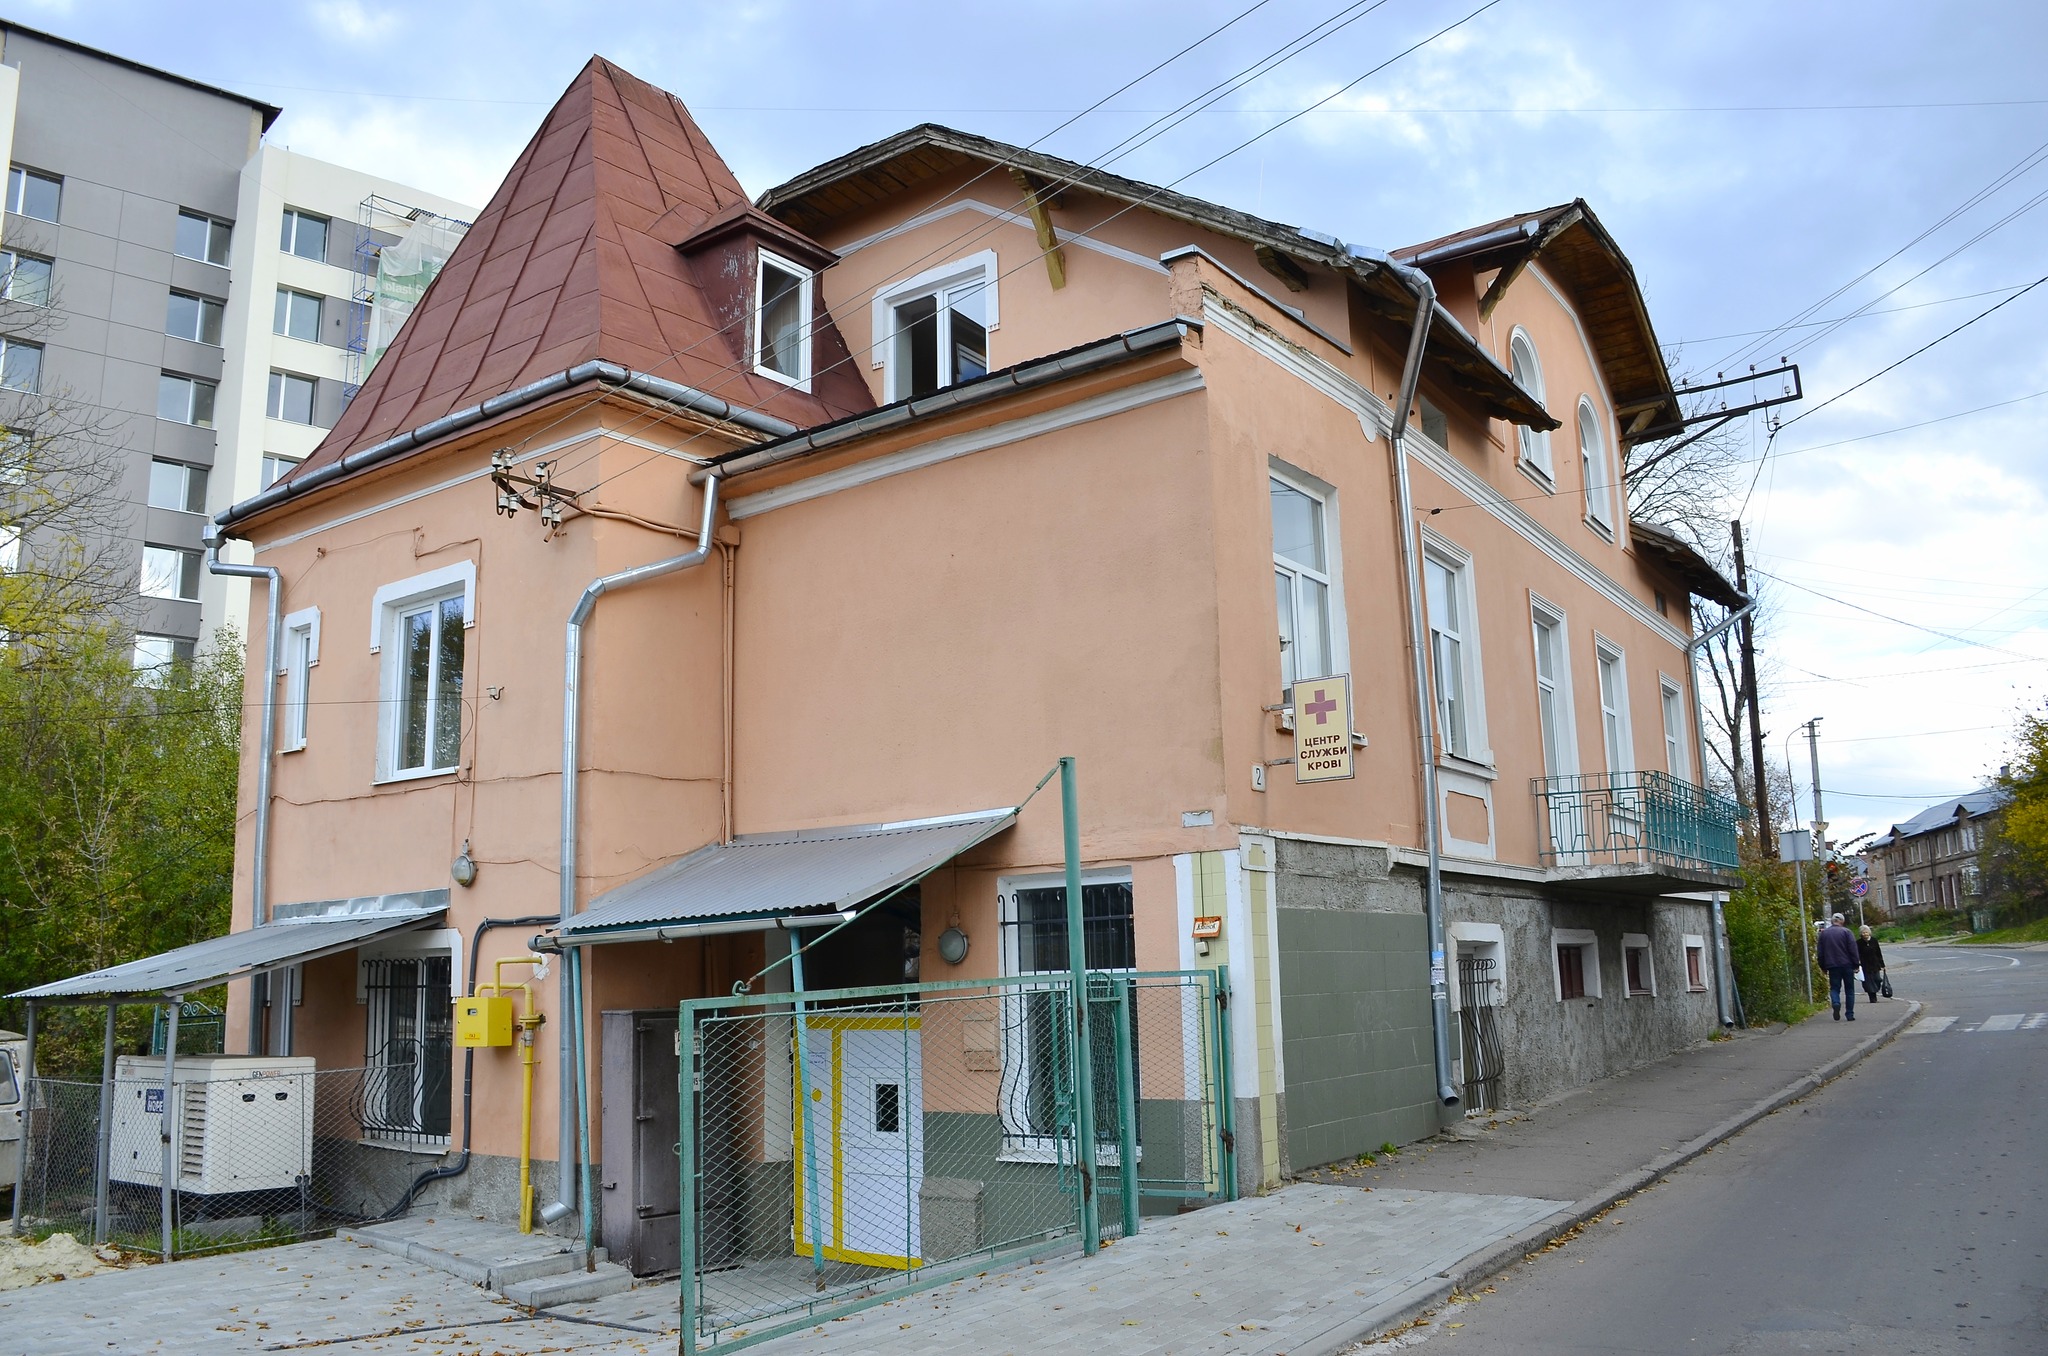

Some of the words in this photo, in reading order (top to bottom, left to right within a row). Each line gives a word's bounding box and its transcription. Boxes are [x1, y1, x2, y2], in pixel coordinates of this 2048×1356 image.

[1304, 735, 1340, 747] ЦЕНТР
[1300, 746, 1347, 759] СЛУЖБИ
[1307, 759, 1341, 770] КРОВІ
[1256, 768, 1261, 785] 2
